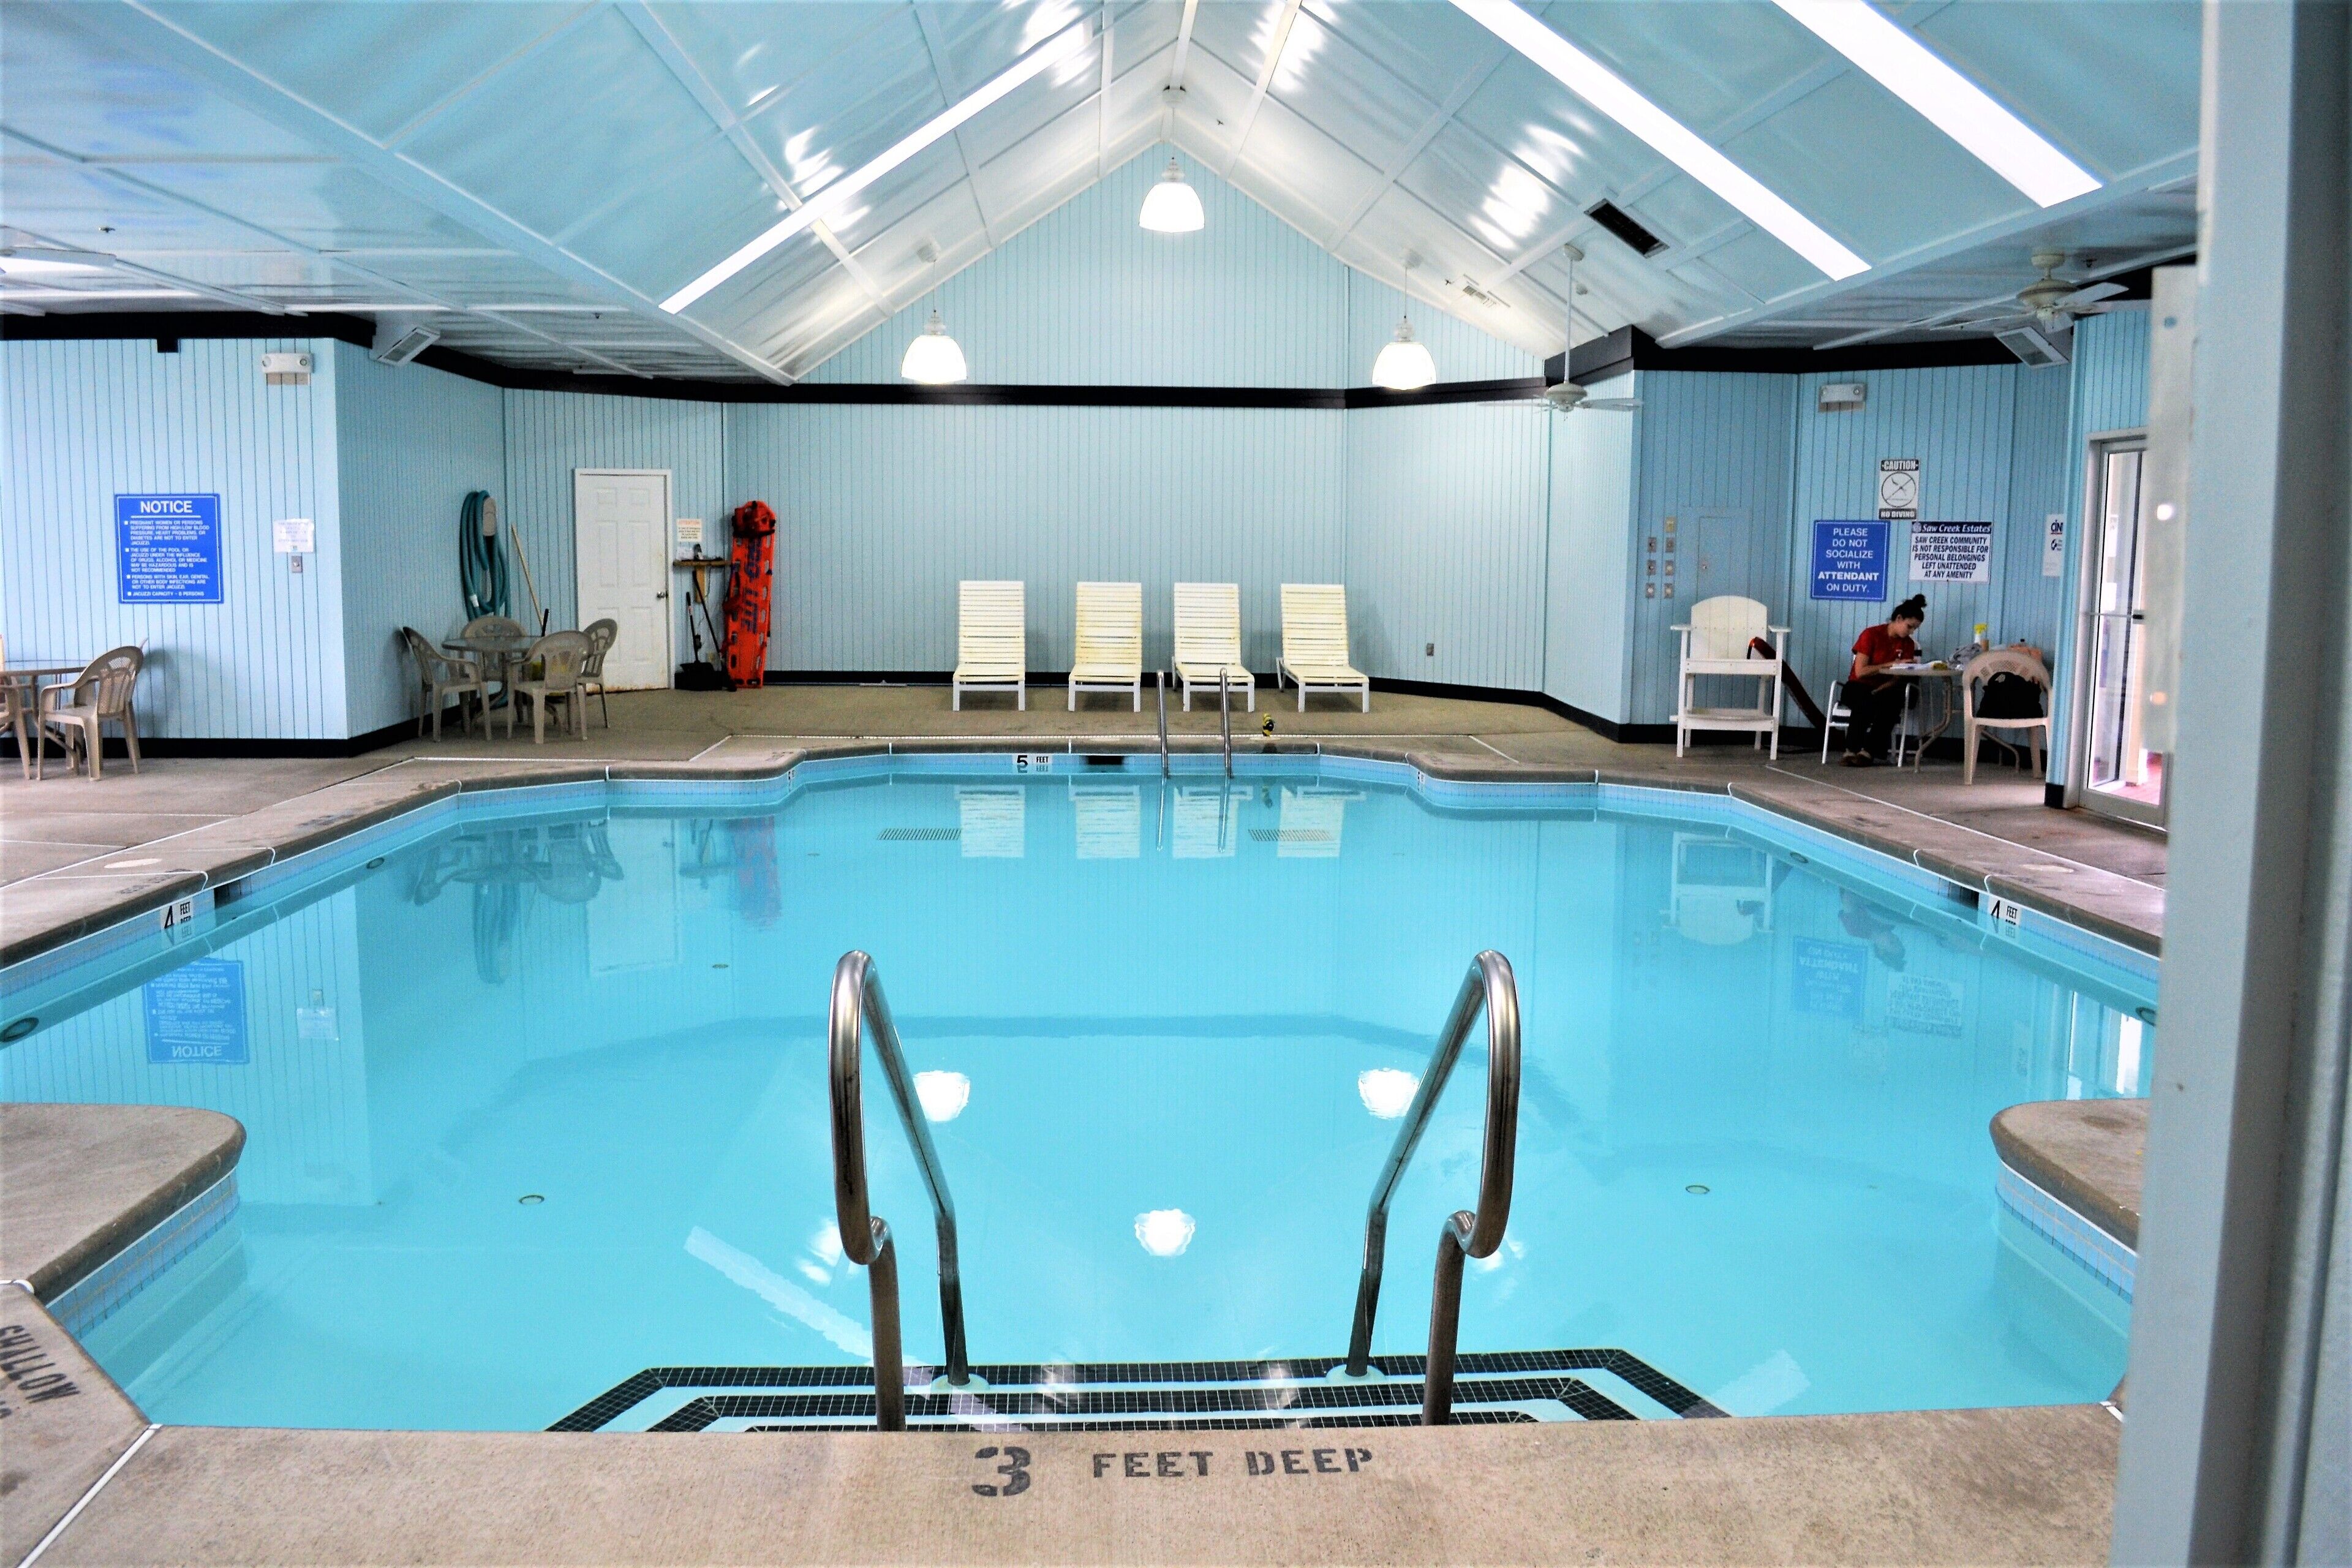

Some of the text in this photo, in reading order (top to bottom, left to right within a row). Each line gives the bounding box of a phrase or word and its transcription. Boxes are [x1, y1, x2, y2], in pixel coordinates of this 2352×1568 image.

[140, 500, 192, 513] NOTICE
[1962, 524, 1990, 533] Estates
[1826, 549, 1873, 559] SOCIALIZE
[1818, 571, 1879, 581] ATTENDANT
[1017, 755, 1028, 766] 5
[180, 902, 190, 915] FEET
[2007, 906, 2018, 919] FEET
[971, 1446, 1373, 1497] 3 FEET DEEP
